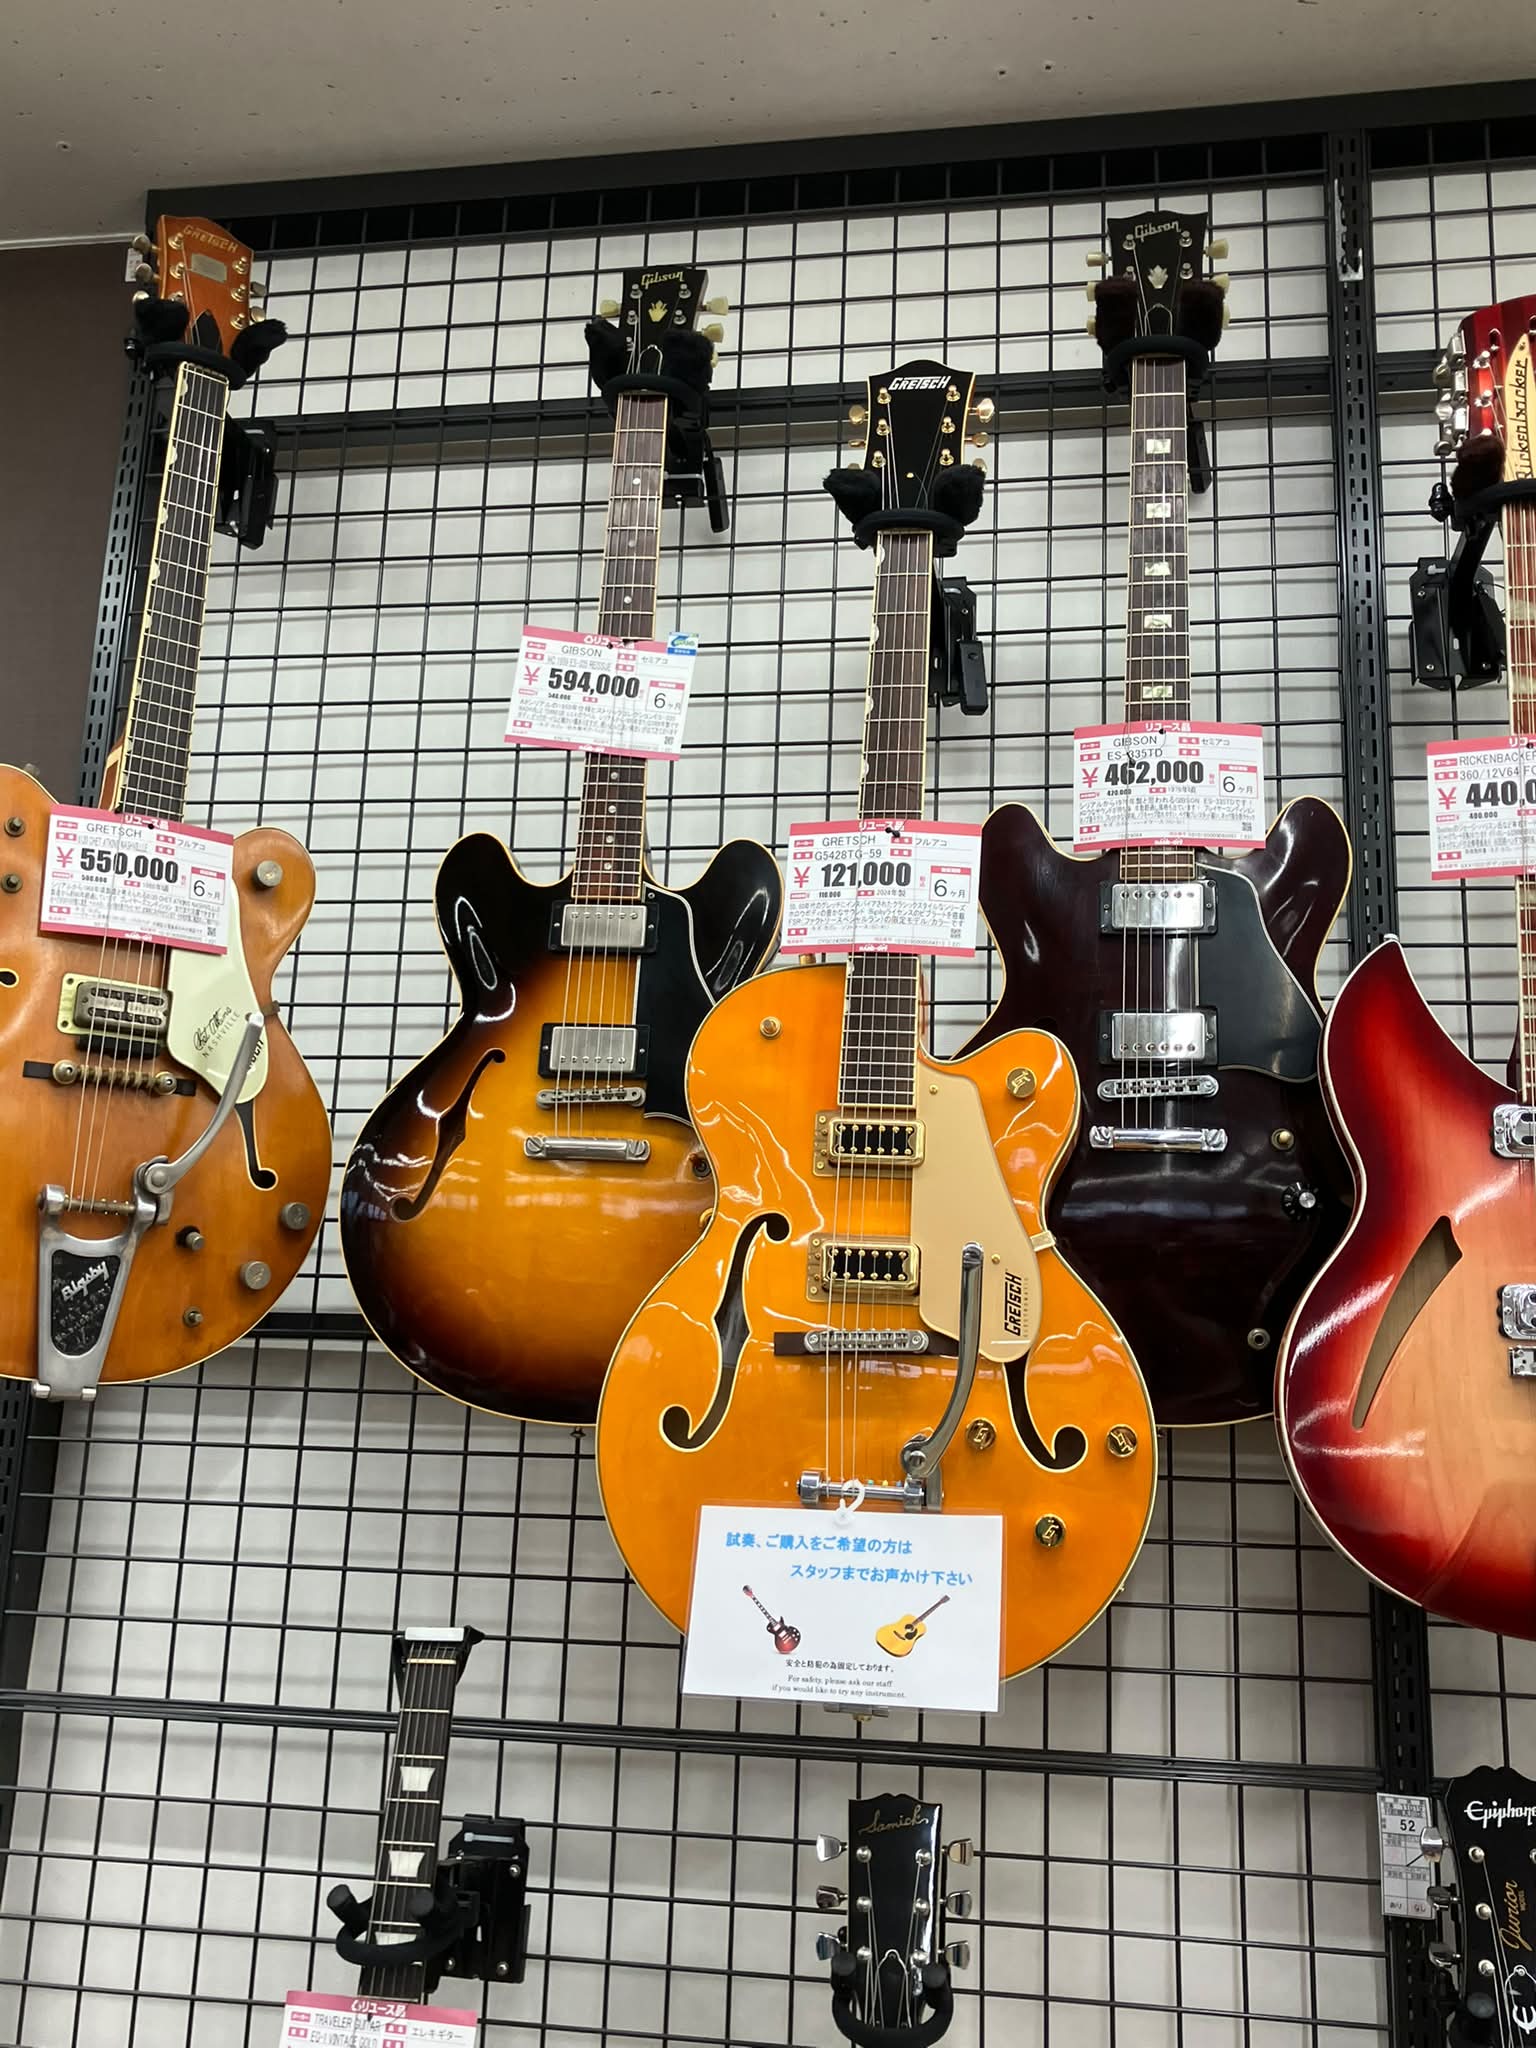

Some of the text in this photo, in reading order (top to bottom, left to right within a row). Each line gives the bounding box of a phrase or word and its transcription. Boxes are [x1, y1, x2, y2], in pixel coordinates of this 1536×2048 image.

[183, 224, 239, 253] GRETSCH
[1134, 220, 1181, 242] Gibson
[641, 271, 685, 290] Gibson
[888, 375, 951, 391] GRETSCH
[561, 645, 602, 657] GIBSON
[523, 665, 540, 685] ¥
[548, 667, 640, 698] 594,000
[1145, 722, 1191, 732] リユース品
[1113, 735, 1157, 748] GIBSON
[1201, 737, 1230, 746] セミアコ
[1107, 748, 1163, 761] ES-335TD
[1081, 767, 1098, 788] ¥
[1104, 760, 1204, 786] 462,000
[1460, 766, 1520, 780] 360/12V64
[1437, 787, 1457, 810] ¥
[86, 823, 142, 838] GRETSCH
[822, 835, 876, 847] GRETSCH
[915, 837, 947, 847] フルアコ
[814, 848, 882, 861] G5428TG-59
[56, 846, 179, 884] ¥ 550,000
[794, 861, 912, 888] ¥ 121,000
[202, 1011, 240, 1058] NASHVILLE
[61, 1260, 110, 1302] Bigsby
[1004, 1272, 1022, 1337] GRETSCH
[725, 1531, 913, 1555] 試奏、ご購入をご希望の方は
[790, 1563, 973, 1586] スタッフまでお声かけ下さい
[785, 1659, 894, 1673] 安全と防犯の為固定しております。
[788, 1674, 800, 1682] For
[825, 1676, 847, 1686] please
[848, 1678, 861, 1686] ask
[876, 1679, 894, 1688] staff
[779, 1685, 792, 1693] you
[793, 1685, 814, 1693] would
[815, 1686, 829, 1694] like
[838, 1688, 849, 1696] try
[858, 1804, 929, 1834] Samick
[1400, 1819, 1416, 1832] 52
[1499, 1880, 1534, 1951] Junior
[362, 2001, 407, 2018] リユース品
[314, 2013, 352, 2029] TRAVELER
[411, 2026, 463, 2040] エレキギター
